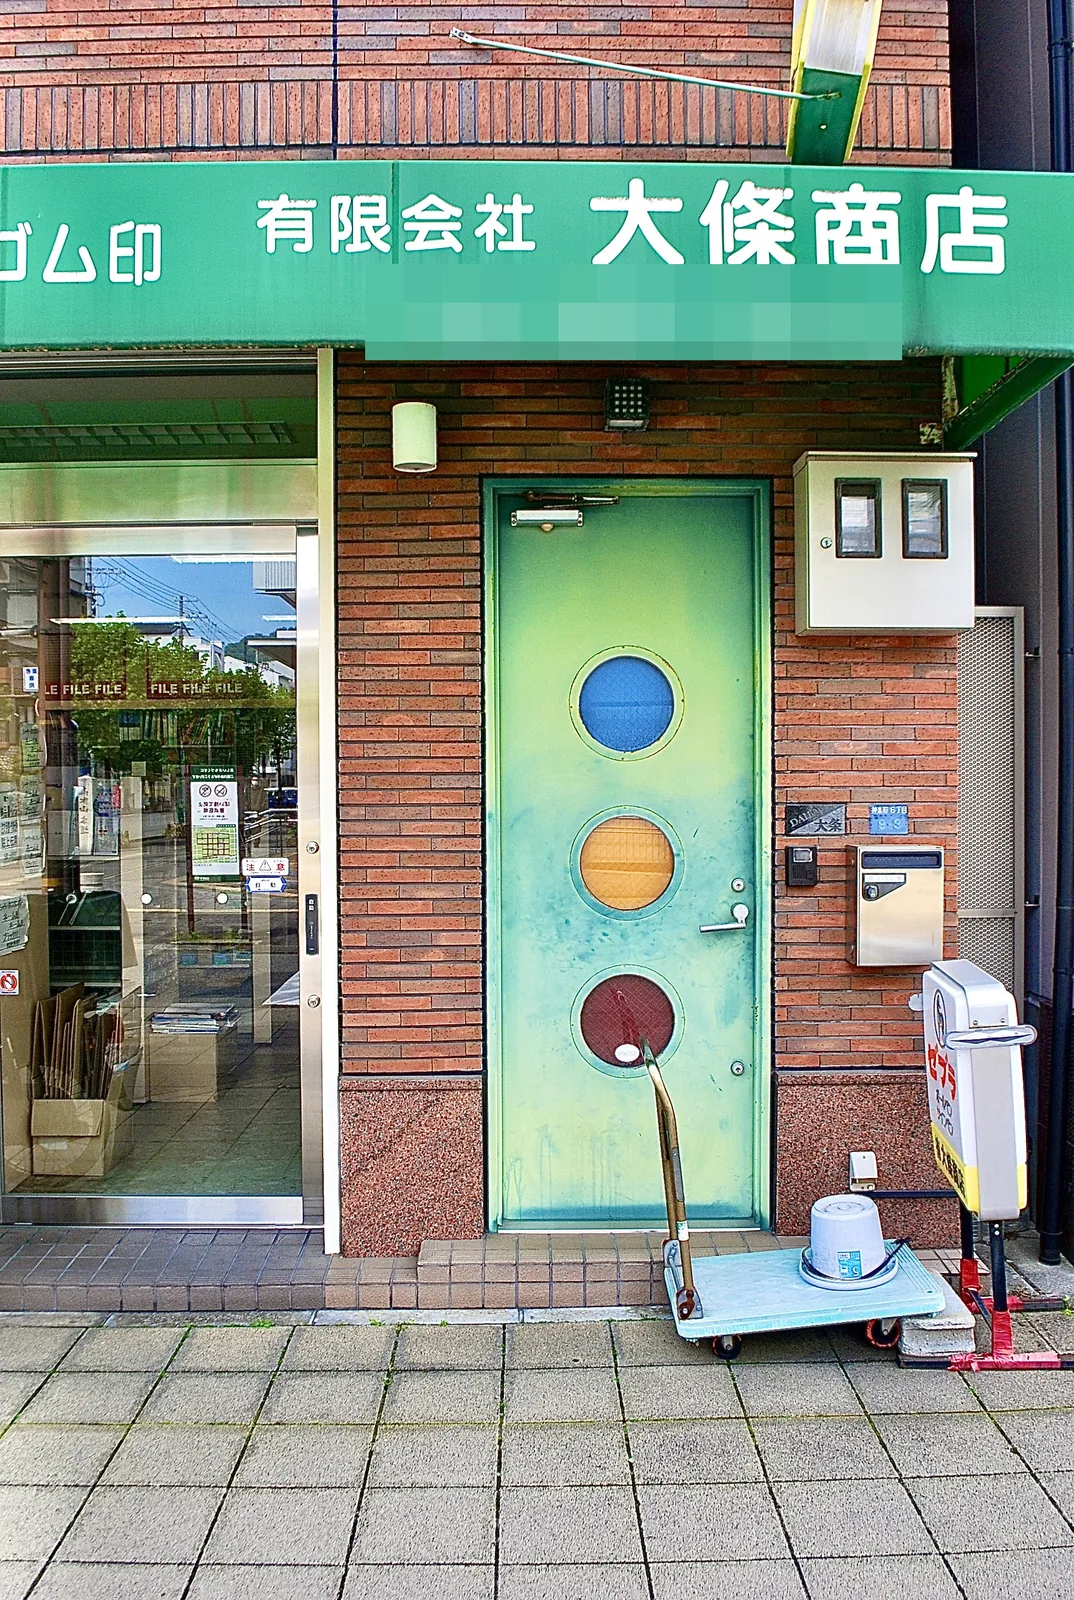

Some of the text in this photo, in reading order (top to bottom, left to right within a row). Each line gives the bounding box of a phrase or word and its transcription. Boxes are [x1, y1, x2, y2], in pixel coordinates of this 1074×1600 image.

[256, 177, 1008, 275] 有限会社 大條商店
[0, 221, 163, 286] ゴム印
[62, 684, 90, 695] FILE
[94, 684, 122, 694] FILE
[150, 683, 178, 695] FILE
[215, 683, 243, 694] FILE
[813, 818, 843, 833] 大条
[928, 1042, 957, 1101] ゼブラ
